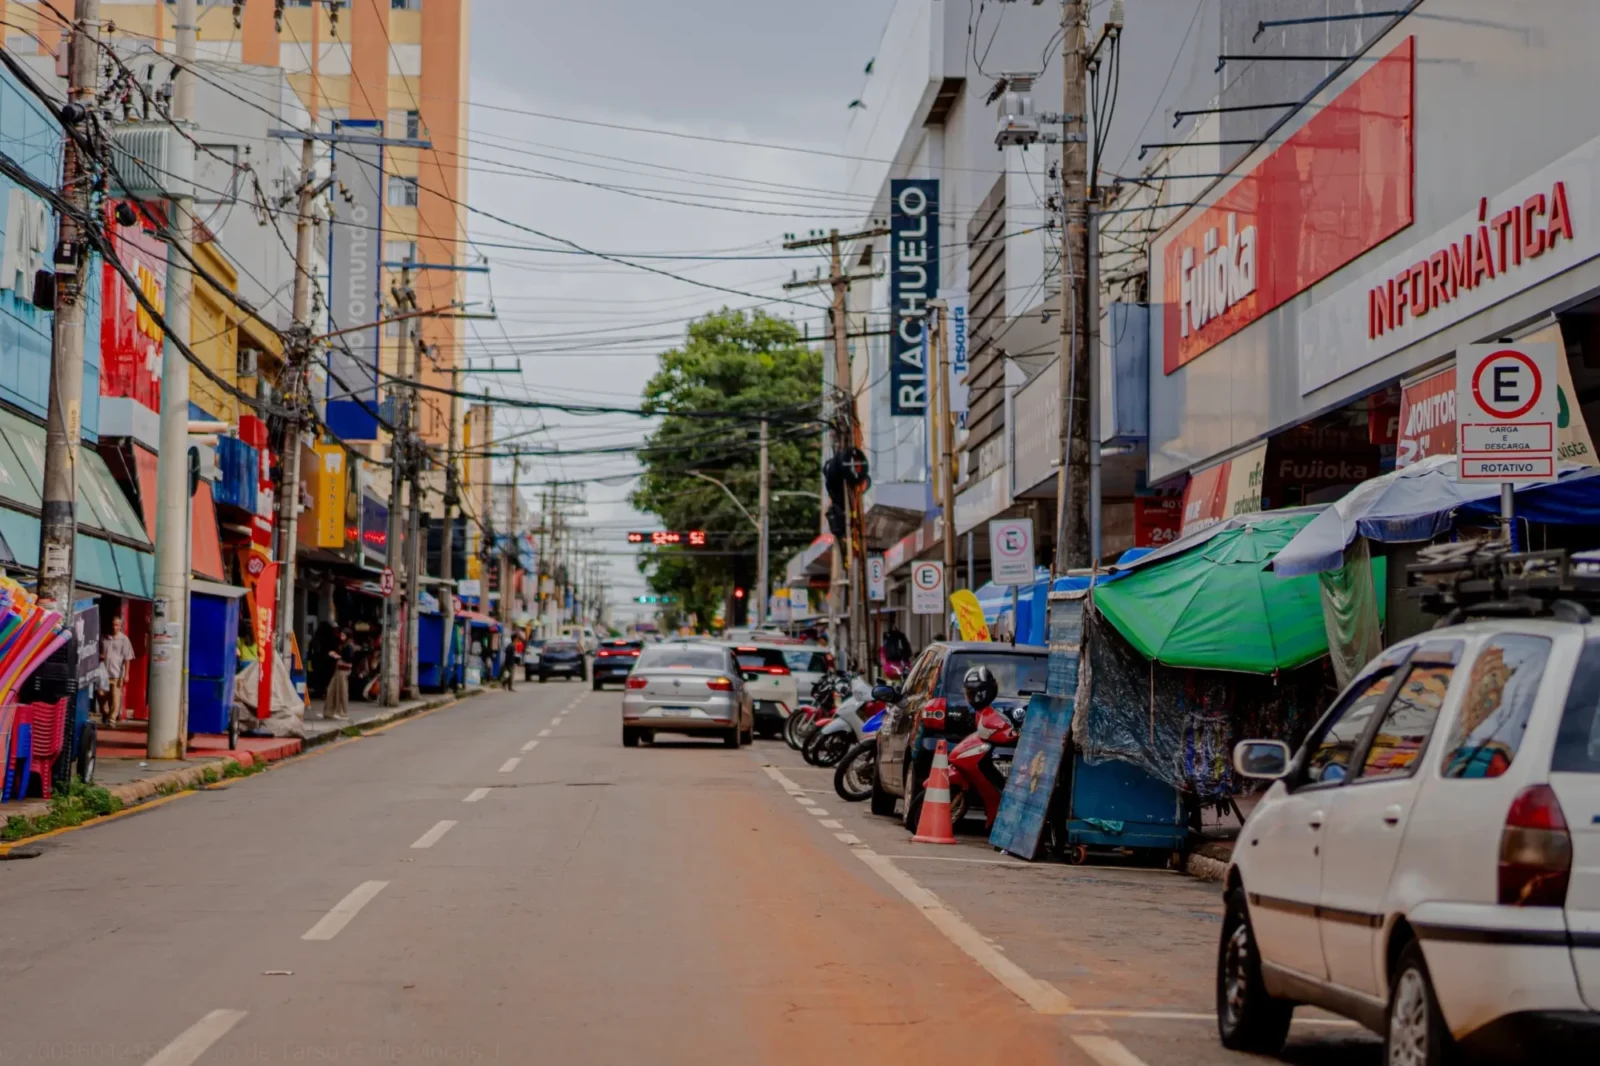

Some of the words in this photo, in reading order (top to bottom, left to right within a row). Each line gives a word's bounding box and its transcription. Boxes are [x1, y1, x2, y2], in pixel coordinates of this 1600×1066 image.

[1180, 211, 1258, 338] Fujioka
[1368, 181, 1574, 340] INFORMÁTICA
[347, 204, 370, 362] novomundo
[898, 186, 928, 409] RIACHUELO
[954, 305, 966, 375] Tesoura
[1493, 366, 1520, 403] E
[1488, 426, 1519, 434] CARGA
[1502, 434, 1508, 442] E
[1484, 442, 1531, 450] DESCARGA
[1279, 459, 1368, 480] Fujioka
[1481, 462, 1534, 473] ROTATIVO
[922, 569, 933, 584] E
